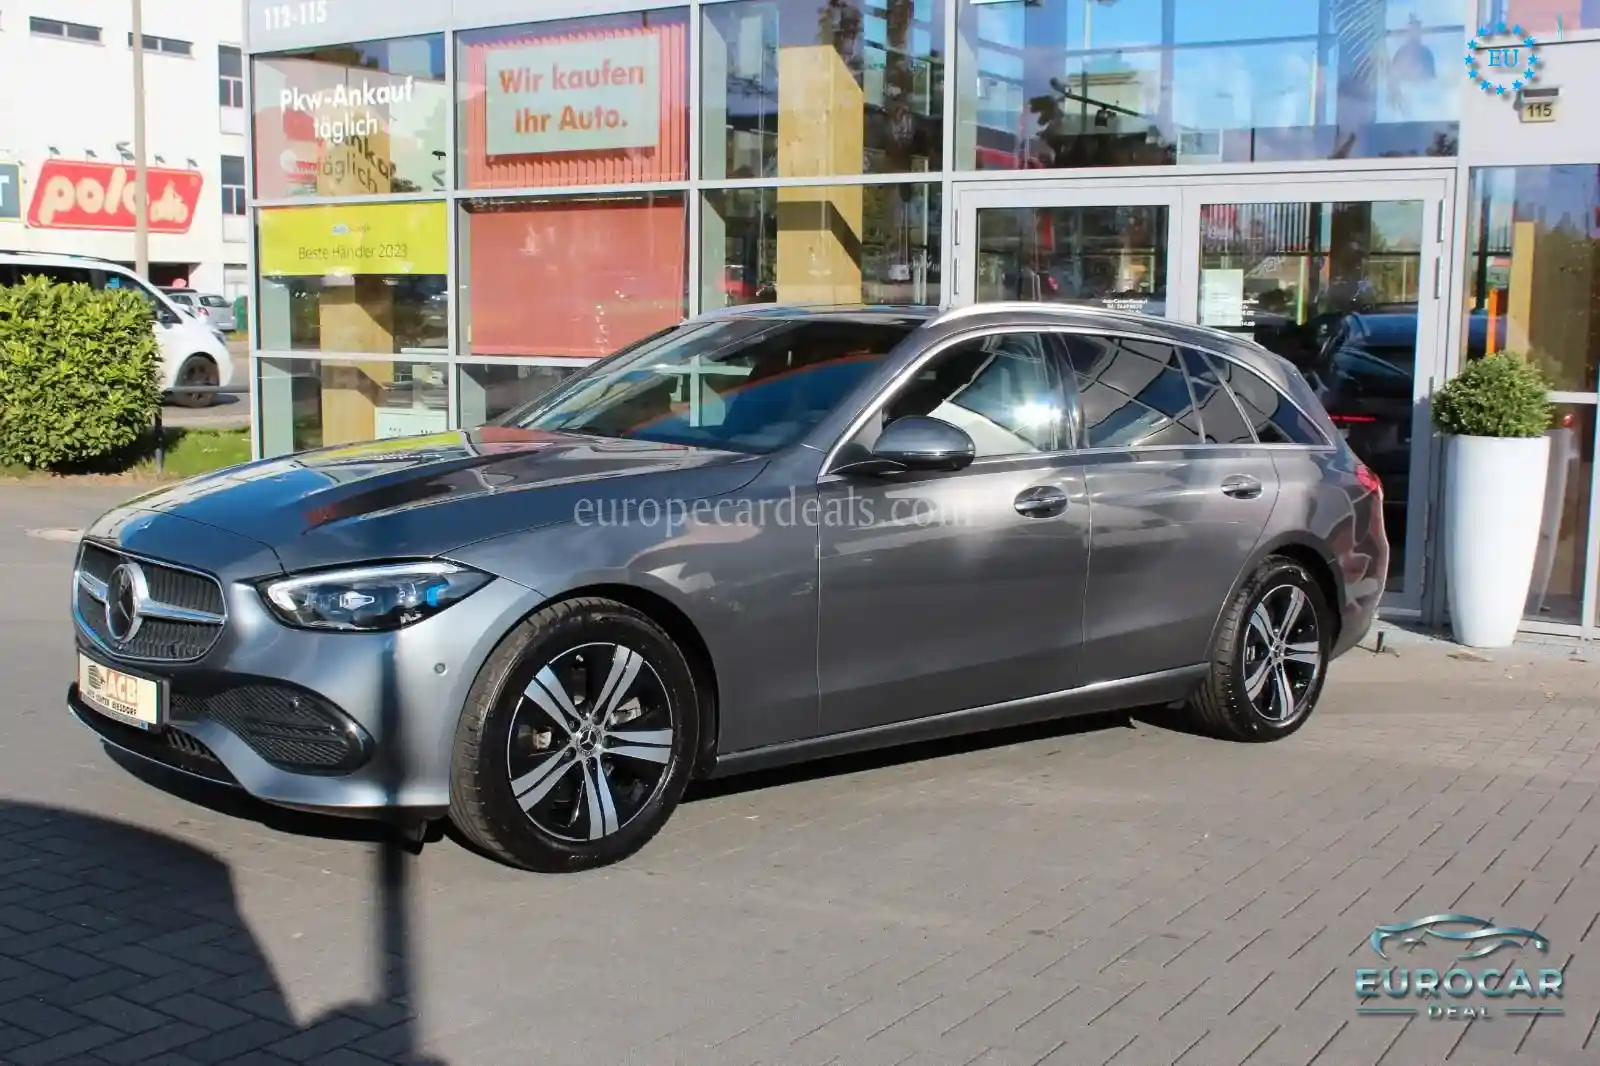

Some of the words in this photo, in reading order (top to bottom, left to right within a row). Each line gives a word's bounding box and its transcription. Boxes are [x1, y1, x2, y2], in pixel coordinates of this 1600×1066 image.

[499, 69, 545, 94] Wir
[552, 58, 644, 91] kaufen
[280, 75, 414, 114] Pkw-Ankauf
[515, 107, 552, 134] Ihr
[559, 104, 628, 131] Auto.
[1526, 103, 1553, 118] 115
[314, 111, 378, 144] täglich
[298, 246, 329, 261] Beste
[332, 242, 375, 260] Händler
[378, 242, 408, 259] 2023
